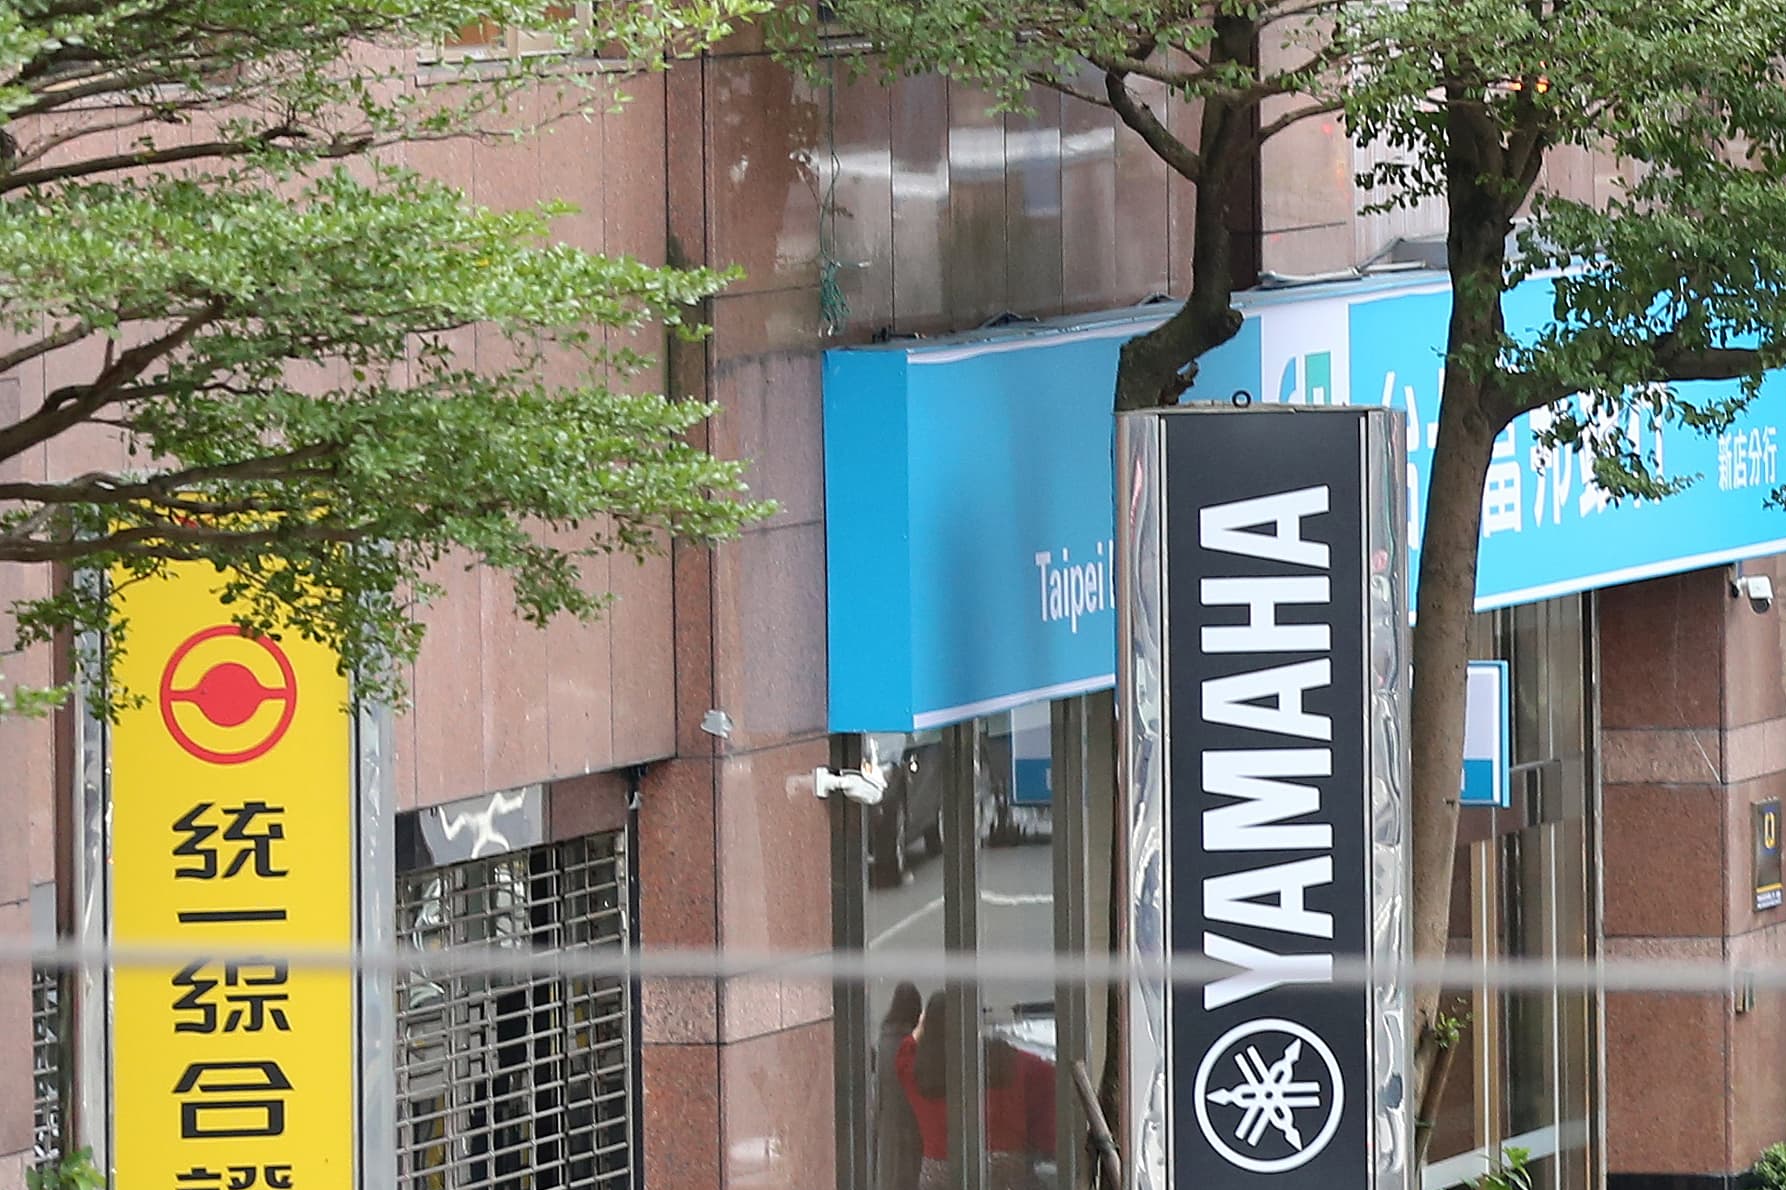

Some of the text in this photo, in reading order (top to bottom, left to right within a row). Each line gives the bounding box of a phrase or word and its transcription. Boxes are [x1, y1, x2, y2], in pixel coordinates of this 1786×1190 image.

[1718, 425, 1777, 491] 新店分行
[1035, 541, 1104, 634] Taipei
[1199, 484, 1334, 1011] YAMAHA
